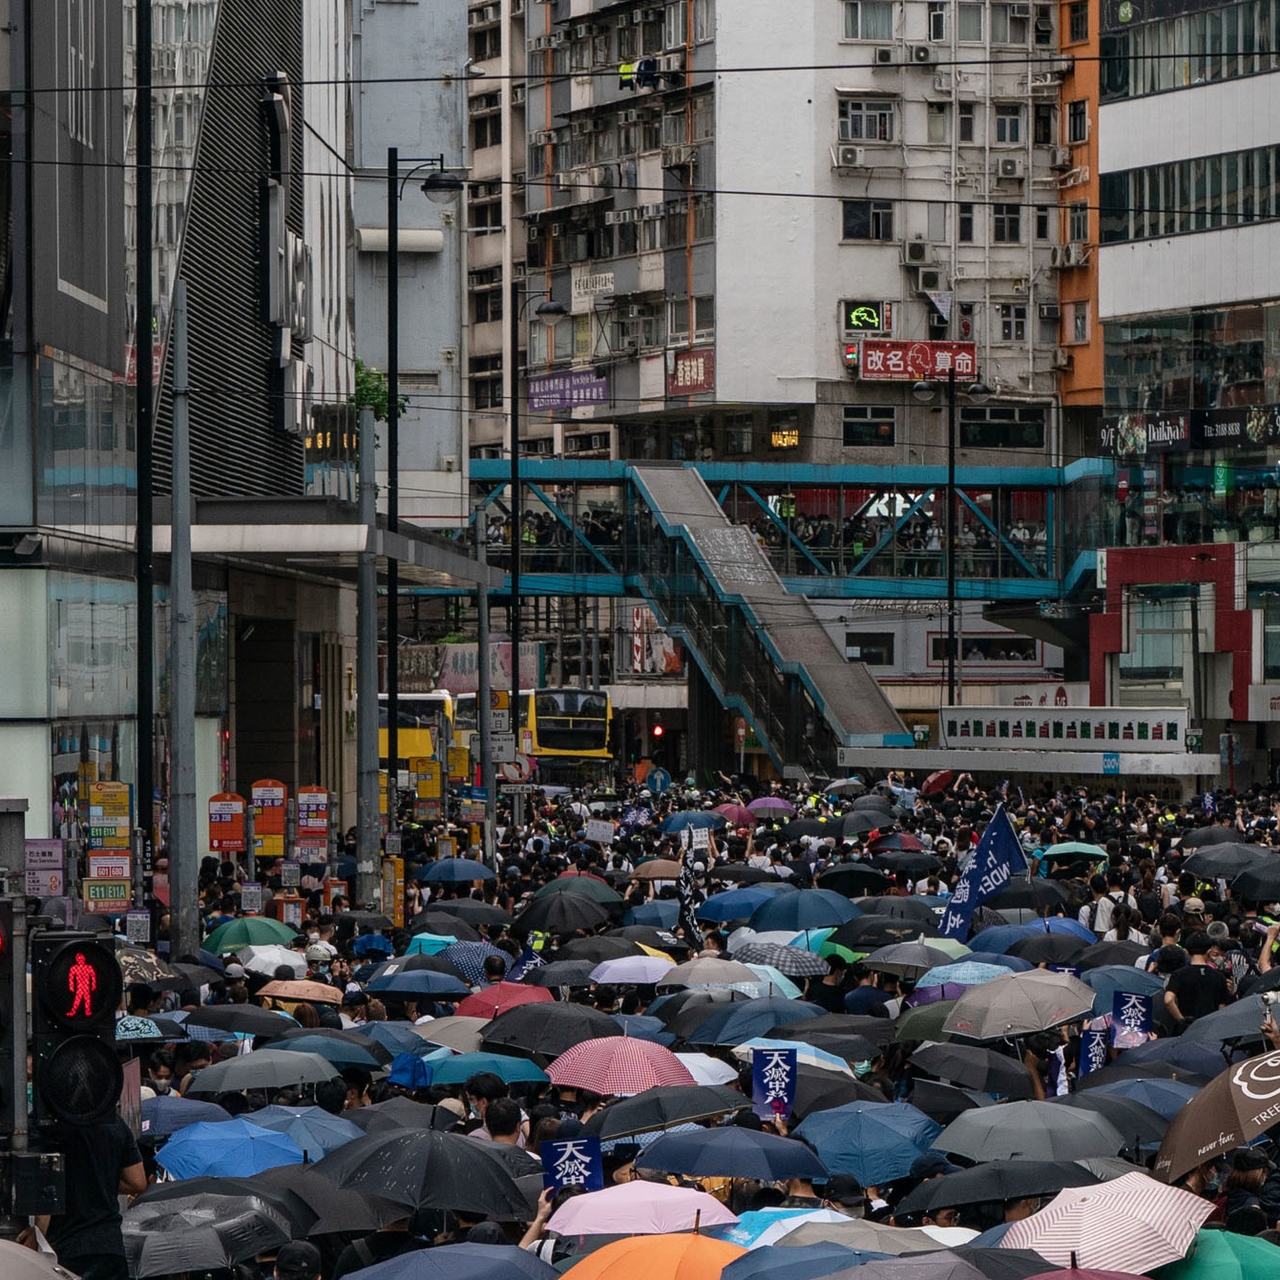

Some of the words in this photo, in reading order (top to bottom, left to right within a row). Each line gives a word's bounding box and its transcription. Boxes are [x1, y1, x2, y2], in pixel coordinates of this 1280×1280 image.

[867, 350, 905, 373] 改名
[934, 351, 973, 374] 算命
[1100, 427, 1116, 446] 9/F
[89, 885, 104, 899] E11
[107, 885, 125, 899] E11A
[1119, 993, 1145, 1037] 天滅中共
[759, 1051, 788, 1104] 天滅中共
